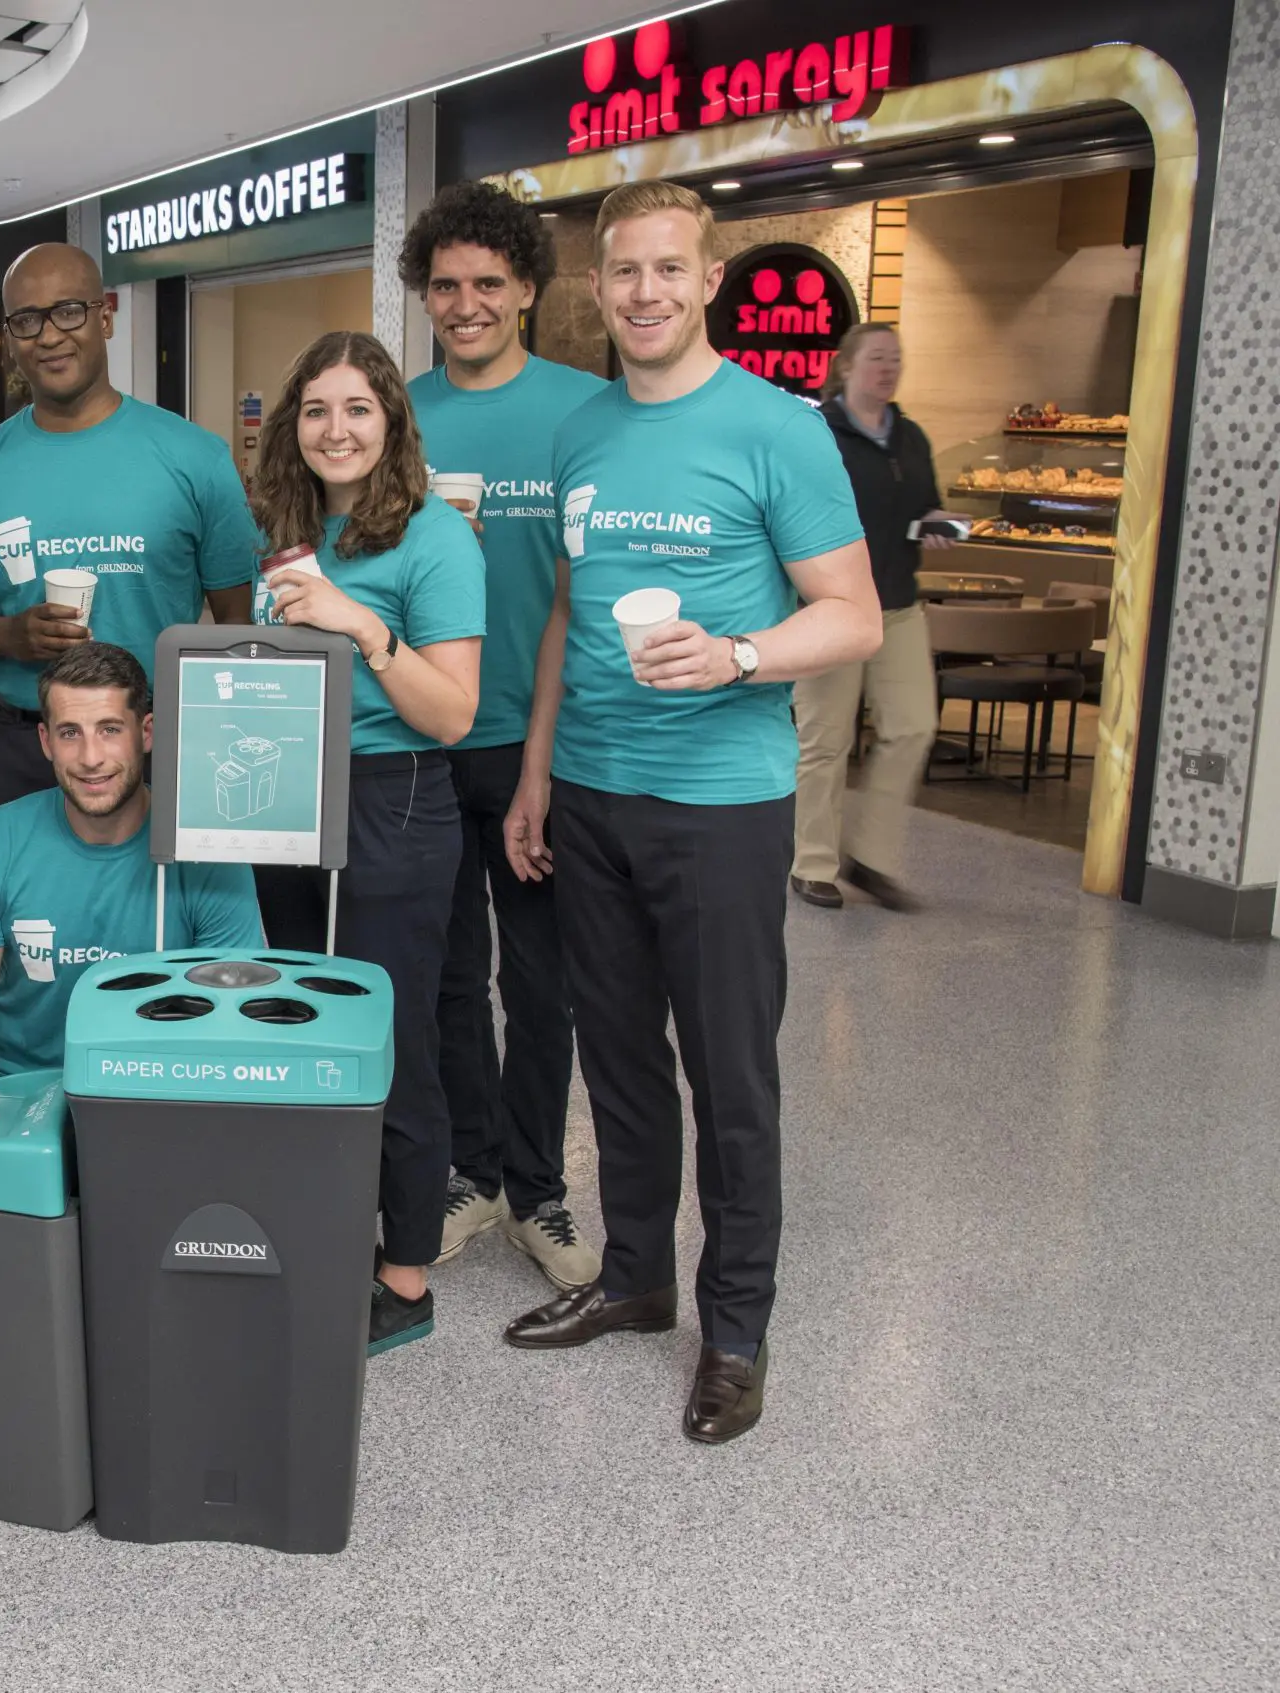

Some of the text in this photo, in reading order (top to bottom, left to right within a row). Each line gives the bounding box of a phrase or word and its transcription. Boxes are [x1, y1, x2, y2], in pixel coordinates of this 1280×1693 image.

[107, 153, 346, 254] STARBUCKS COFFEE
[482, 509, 502, 518] from
[590, 510, 712, 535] RECYCLING
[37, 536, 145, 557] RECYCLING
[628, 541, 710, 556] from GRUNDON
[97, 563, 144, 573] GRUNDON
[234, 682, 281, 690] RECYCLING
[17, 942, 53, 962] CUP
[101, 1060, 290, 1081] PAPER CUPS ONLY
[175, 1241, 266, 1258] GRUNDON
